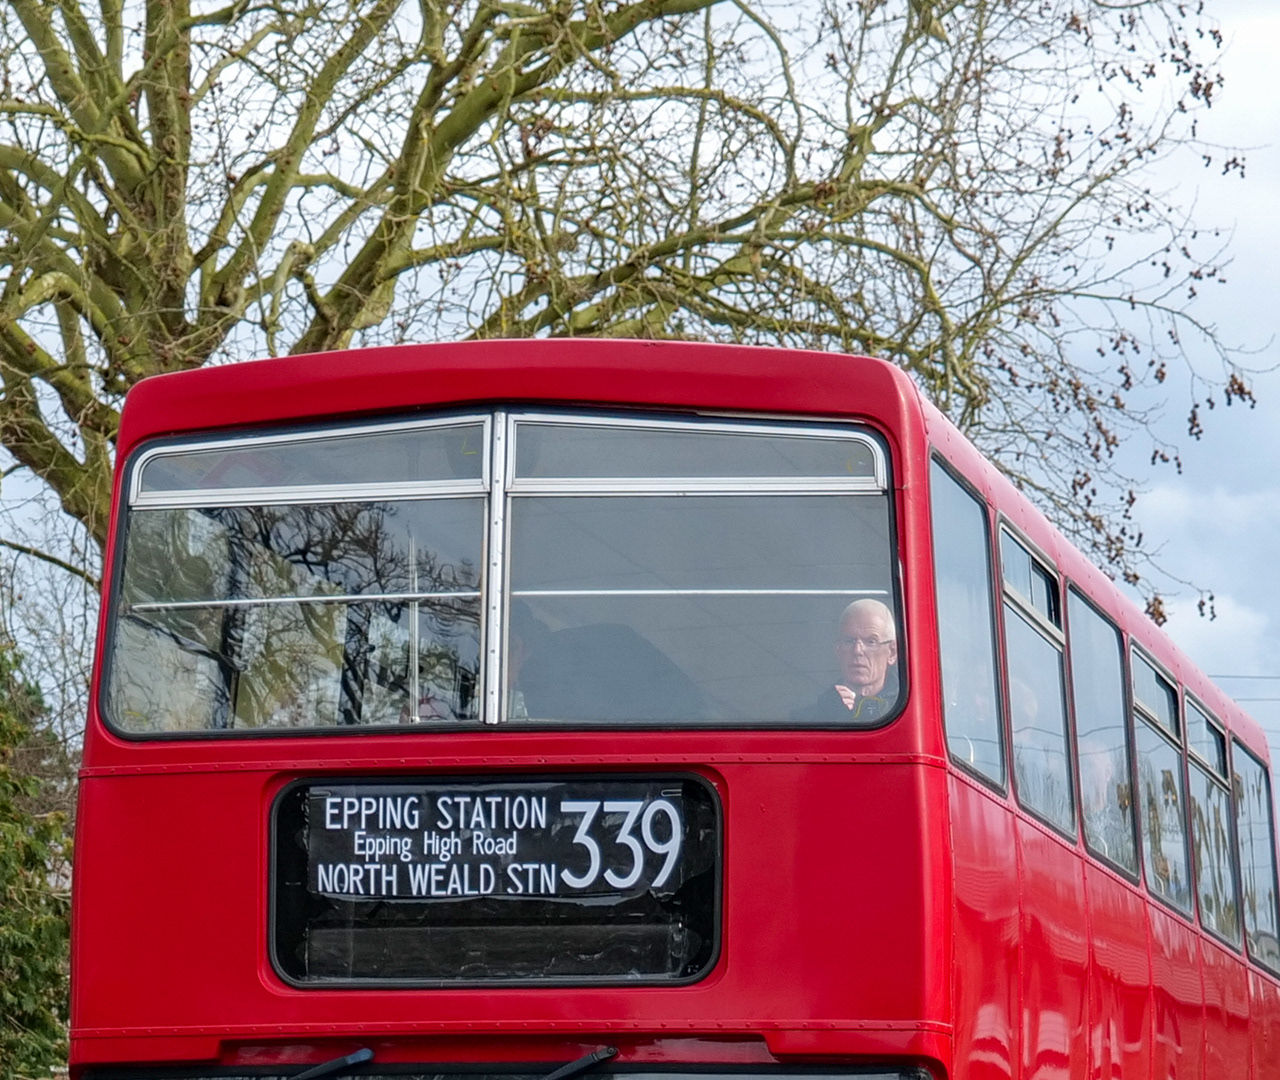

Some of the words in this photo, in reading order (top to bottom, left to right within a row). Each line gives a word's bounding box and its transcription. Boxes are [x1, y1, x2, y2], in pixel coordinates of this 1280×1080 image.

[325, 796, 419, 829] EPPING
[436, 796, 547, 829] STATION
[354, 831, 412, 862] Epping
[423, 831, 461, 861] High
[473, 831, 517, 854] Road
[560, 799, 683, 889] 339
[318, 863, 397, 895] NORTH
[408, 863, 495, 896] WEALD
[507, 863, 555, 894] STN
